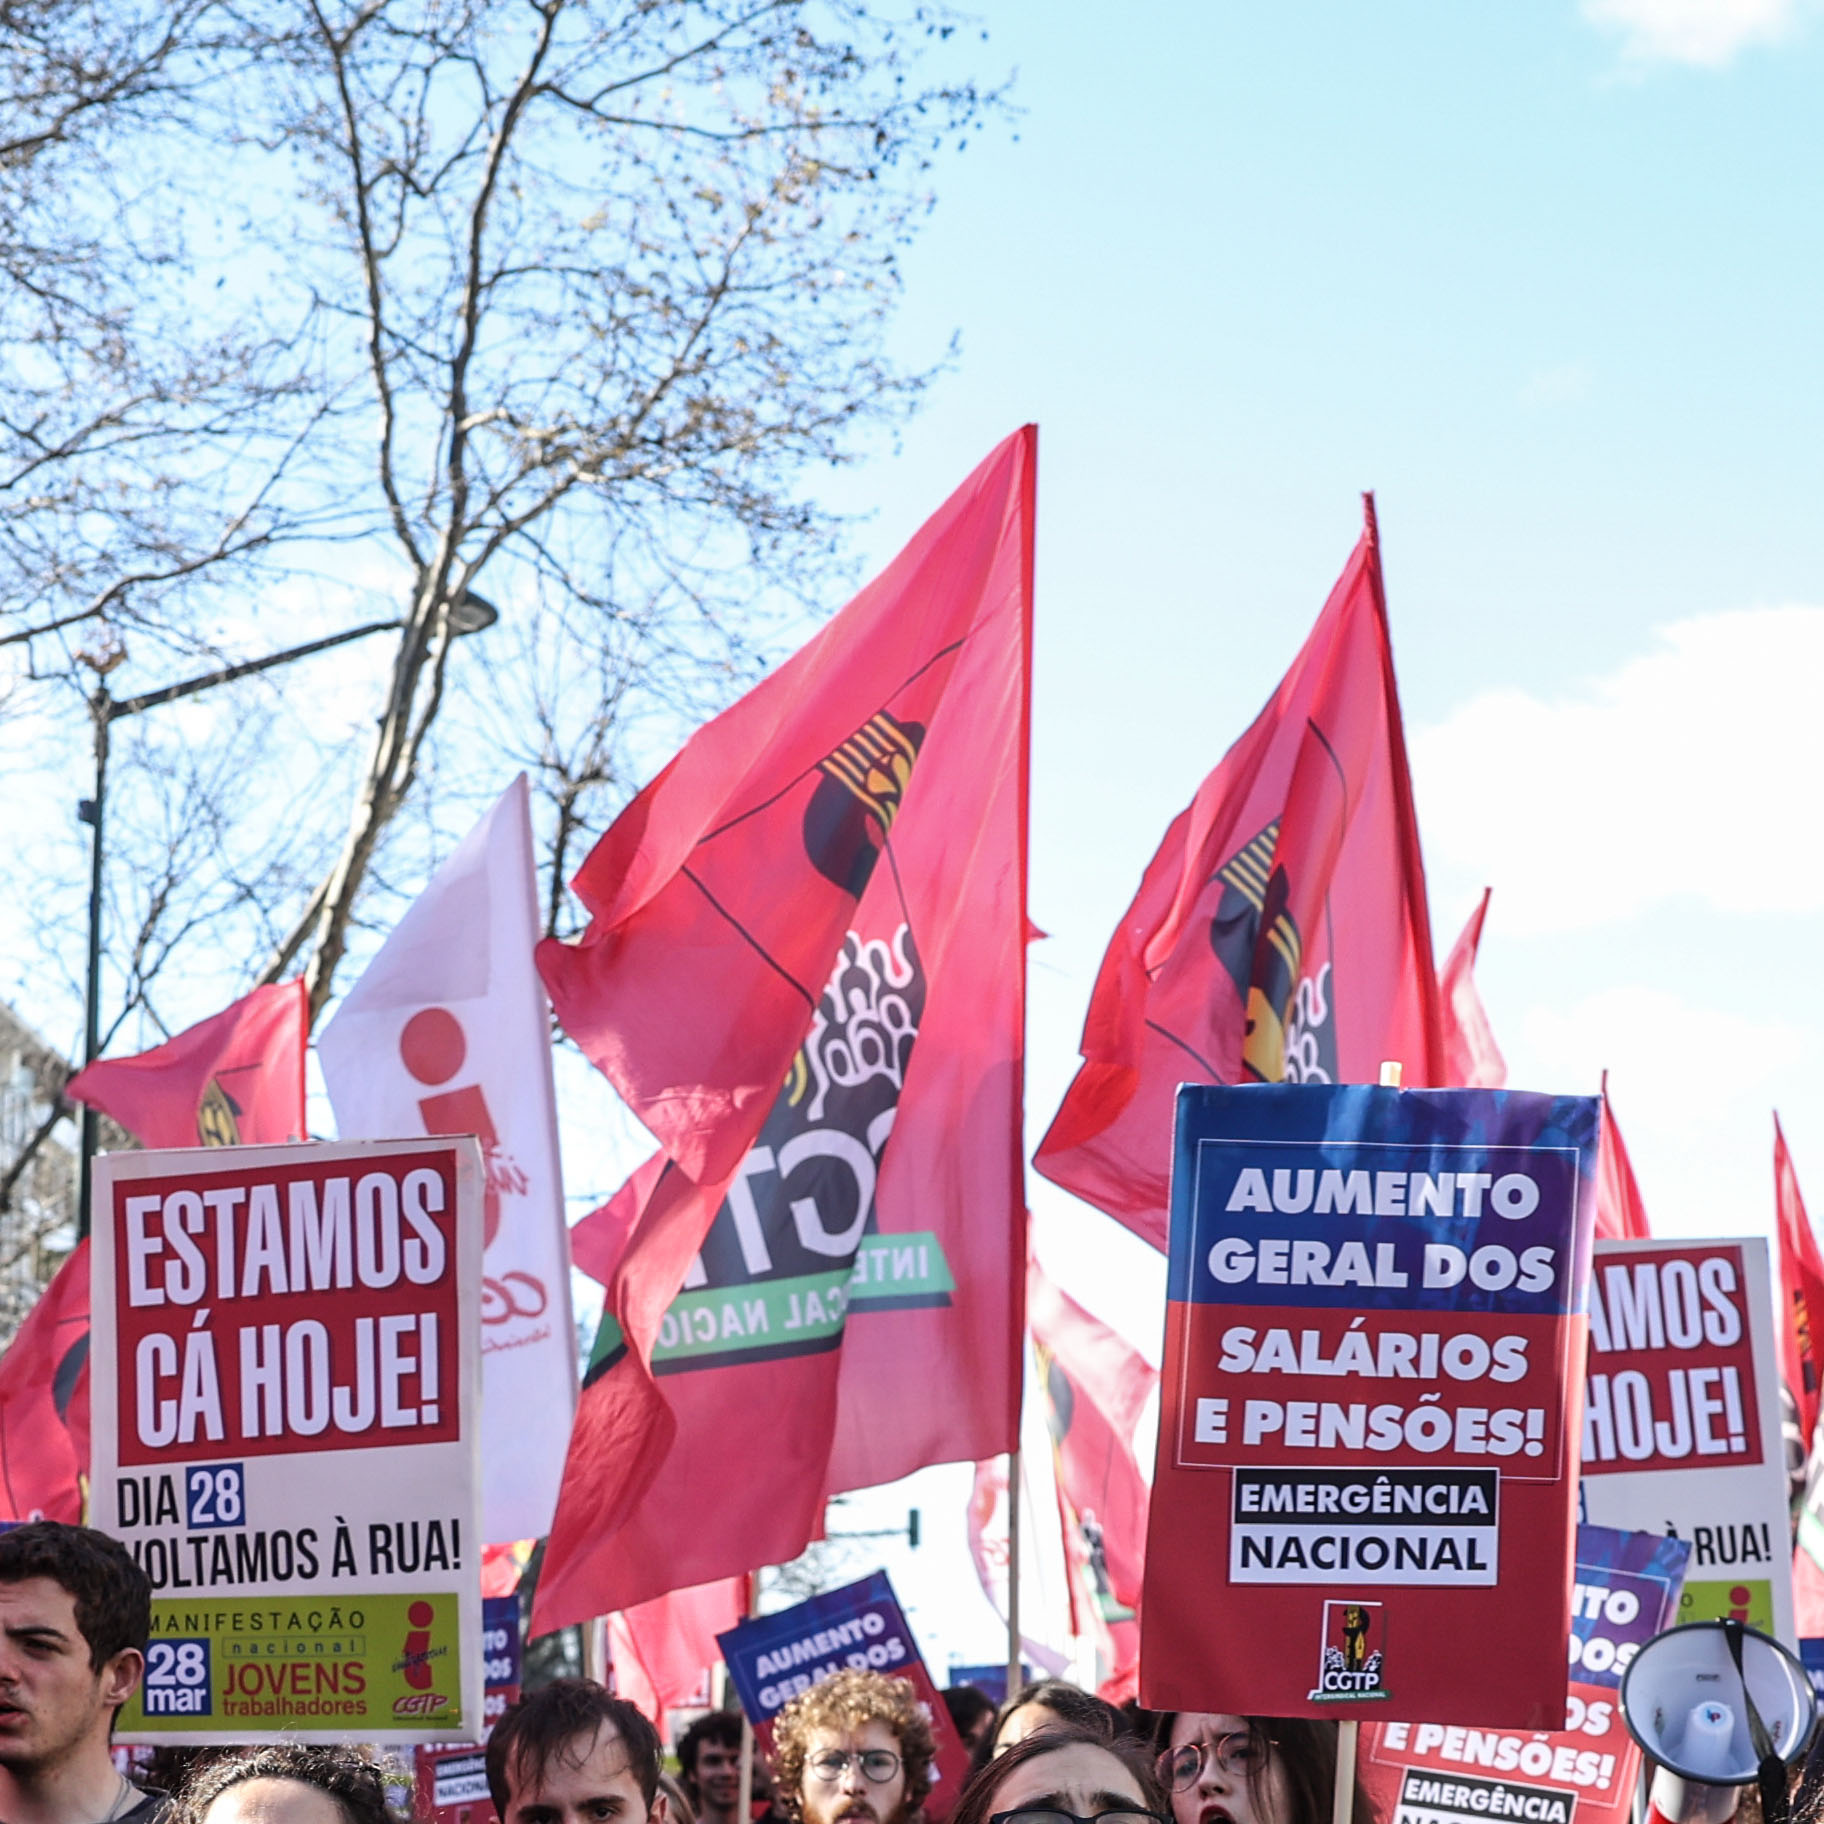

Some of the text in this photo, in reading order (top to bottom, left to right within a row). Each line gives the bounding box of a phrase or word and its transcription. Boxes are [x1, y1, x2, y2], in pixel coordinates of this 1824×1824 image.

[1225, 1168, 1540, 1219] AUMENTO
[125, 1167, 446, 1308] ESTAMOS
[1208, 1238, 1556, 1293] GERAL DOS
[1218, 1316, 1529, 1383] SALÁRIOS
[136, 1308, 440, 1449] CÁ HOJE!
[1194, 1393, 1545, 1457] E PENSÕES!
[1581, 1366, 1747, 1464] HOJE!
[116, 1468, 241, 1528] DIA 28
[1240, 1476, 1489, 1515] EMERGÊNCIA
[332, 1516, 358, 1578] À
[369, 1518, 462, 1576] RUA!
[1240, 1536, 1488, 1571] NACIONAL
[1694, 1523, 1772, 1566] RUA!
[149, 1606, 366, 1635] MANIFESTAÇÃO
[146, 1642, 207, 1686] 28
[229, 1640, 357, 1656] nacional
[756, 1613, 885, 1679] AUMENTO
[146, 1688, 207, 1714] mar
[222, 1663, 367, 1696] JOVENS
[1324, 1671, 1380, 1691] CGTP
[222, 1694, 368, 1717] trabalhadores
[1383, 1724, 1618, 1790] E PENSÕES!
[1404, 1779, 1568, 1824] EMERGÊNCIA
